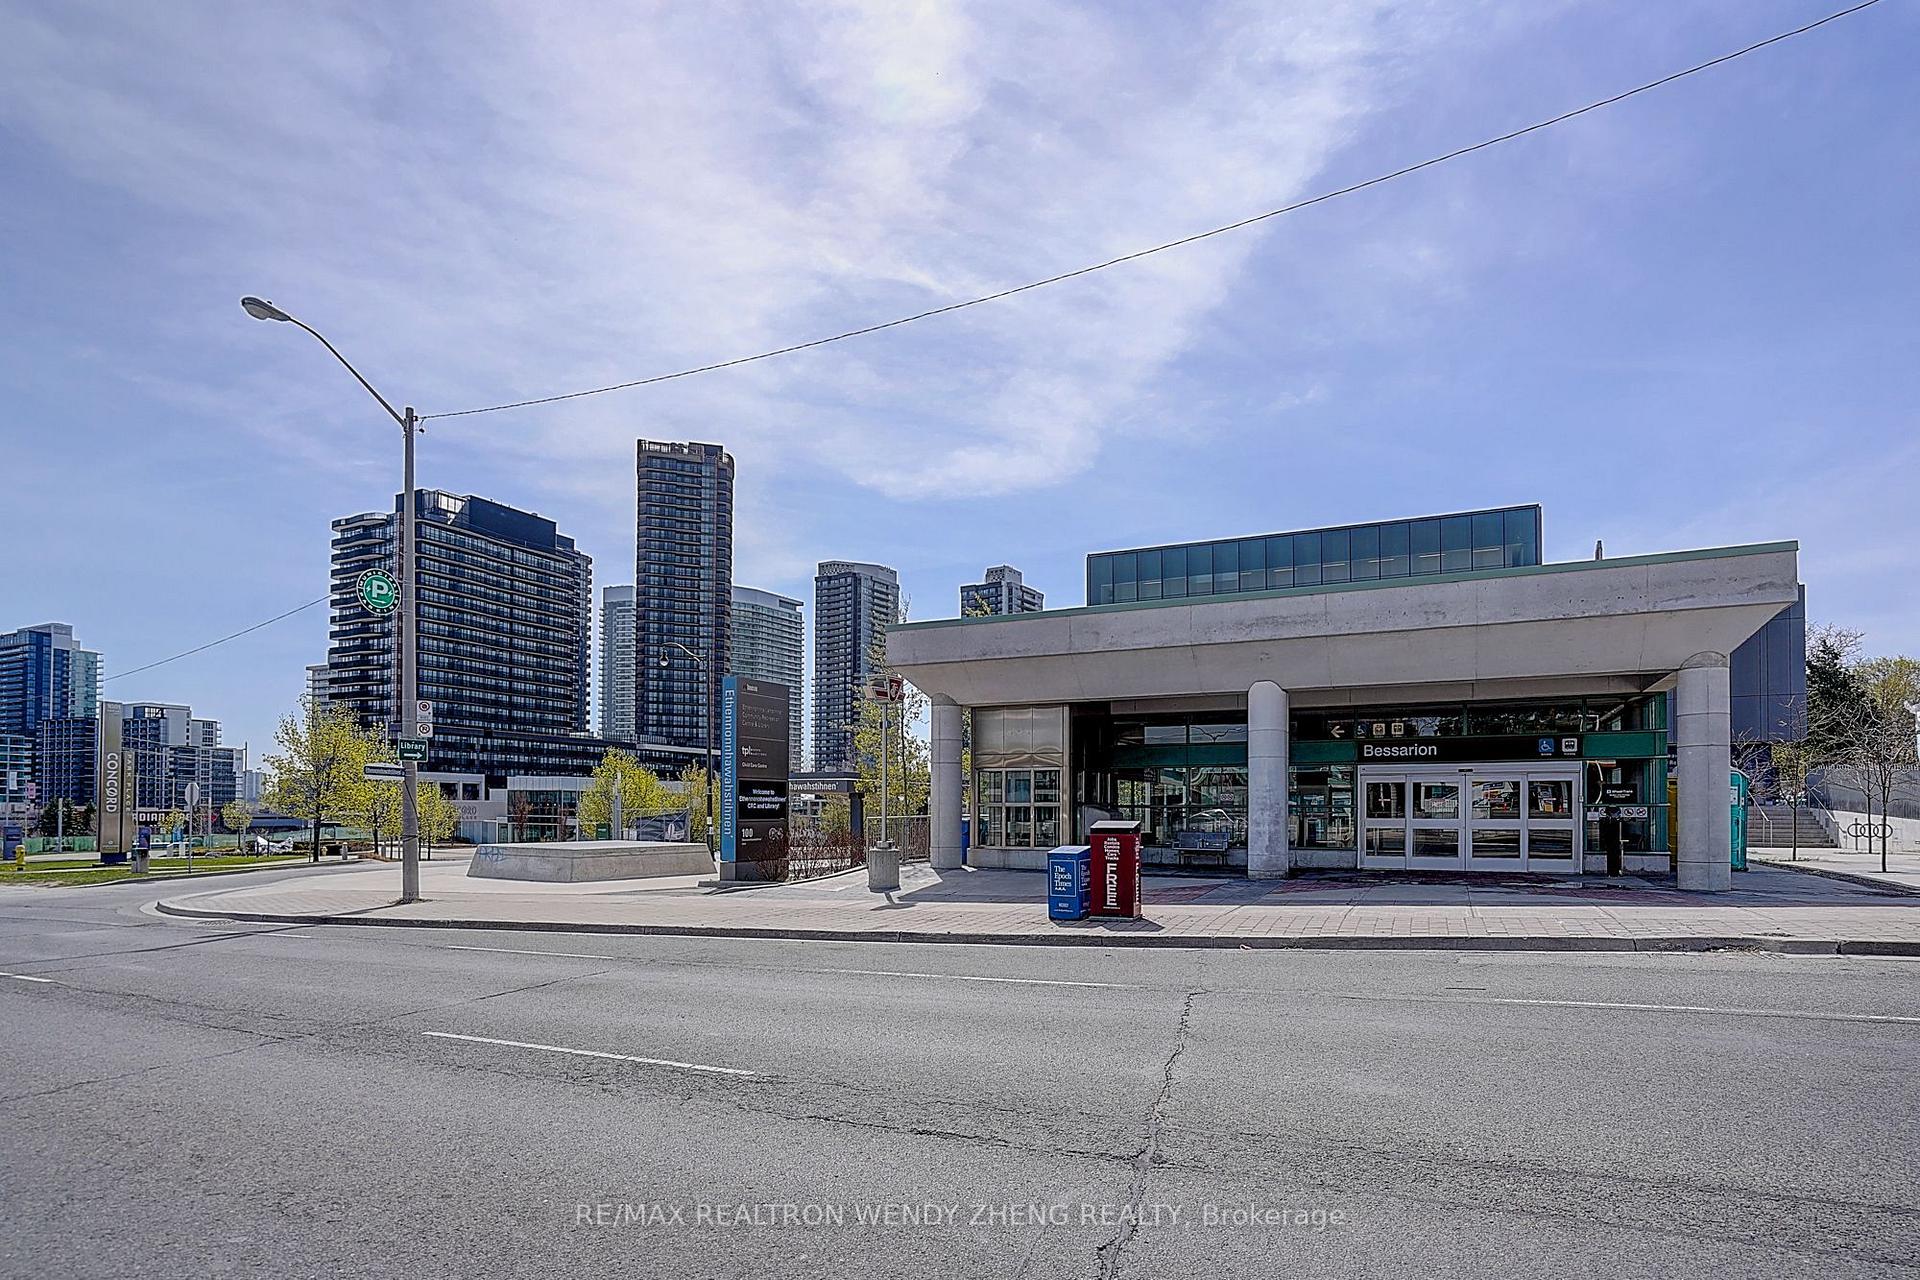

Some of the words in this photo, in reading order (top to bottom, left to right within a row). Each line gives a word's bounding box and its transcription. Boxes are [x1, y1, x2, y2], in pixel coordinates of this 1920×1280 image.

[372, 579, 388, 598] P
[400, 741, 426, 752] Library
[1363, 743, 1437, 757] Bessarion
[789, 781, 839, 791] hawahstihnen'
[741, 828, 754, 838] 100
[1054, 865, 1066, 873] The
[1106, 863, 1118, 906] FREE
